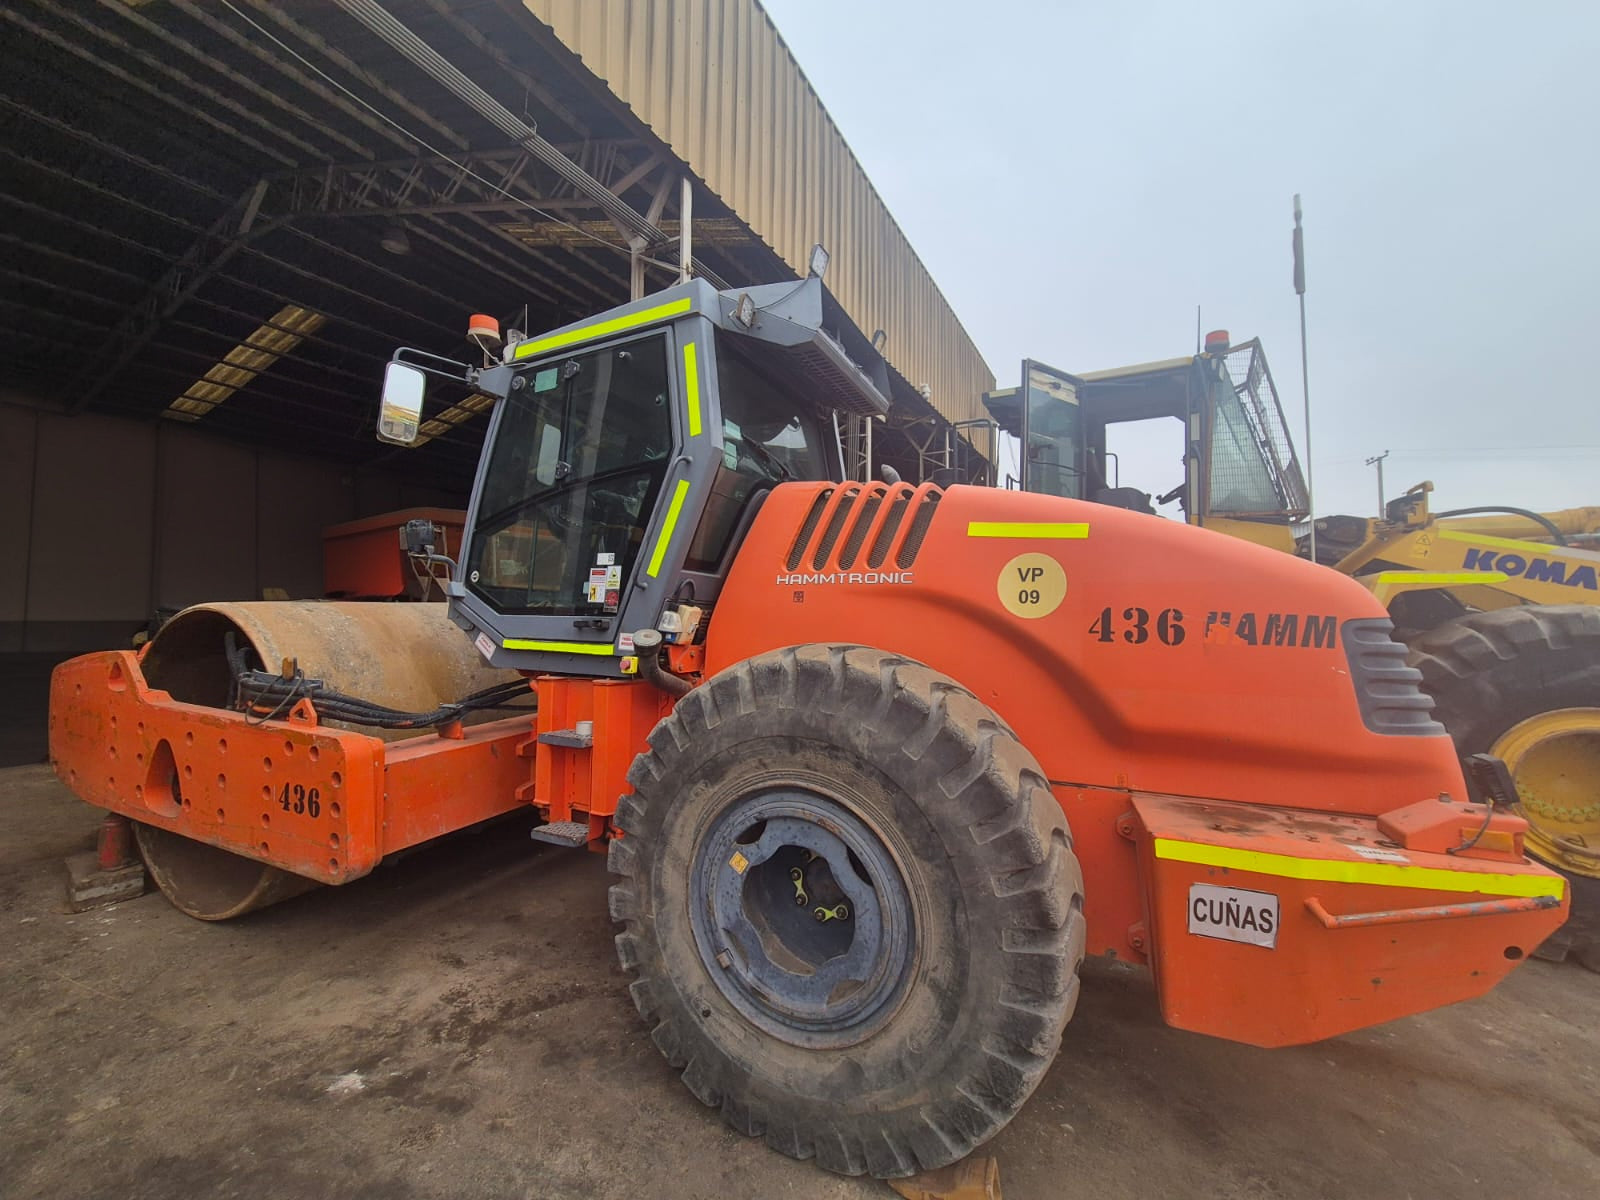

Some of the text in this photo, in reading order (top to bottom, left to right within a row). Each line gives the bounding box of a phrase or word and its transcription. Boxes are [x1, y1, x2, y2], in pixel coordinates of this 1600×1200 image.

[776, 572, 913, 585] HAMMTRONIC
[1017, 567, 1044, 582] VP
[1462, 548, 1600, 590] KOMA
[1018, 589, 1040, 604] 09
[1088, 607, 1186, 646] 436
[279, 782, 320, 818] 436
[1193, 897, 1274, 934] CUÑAS
